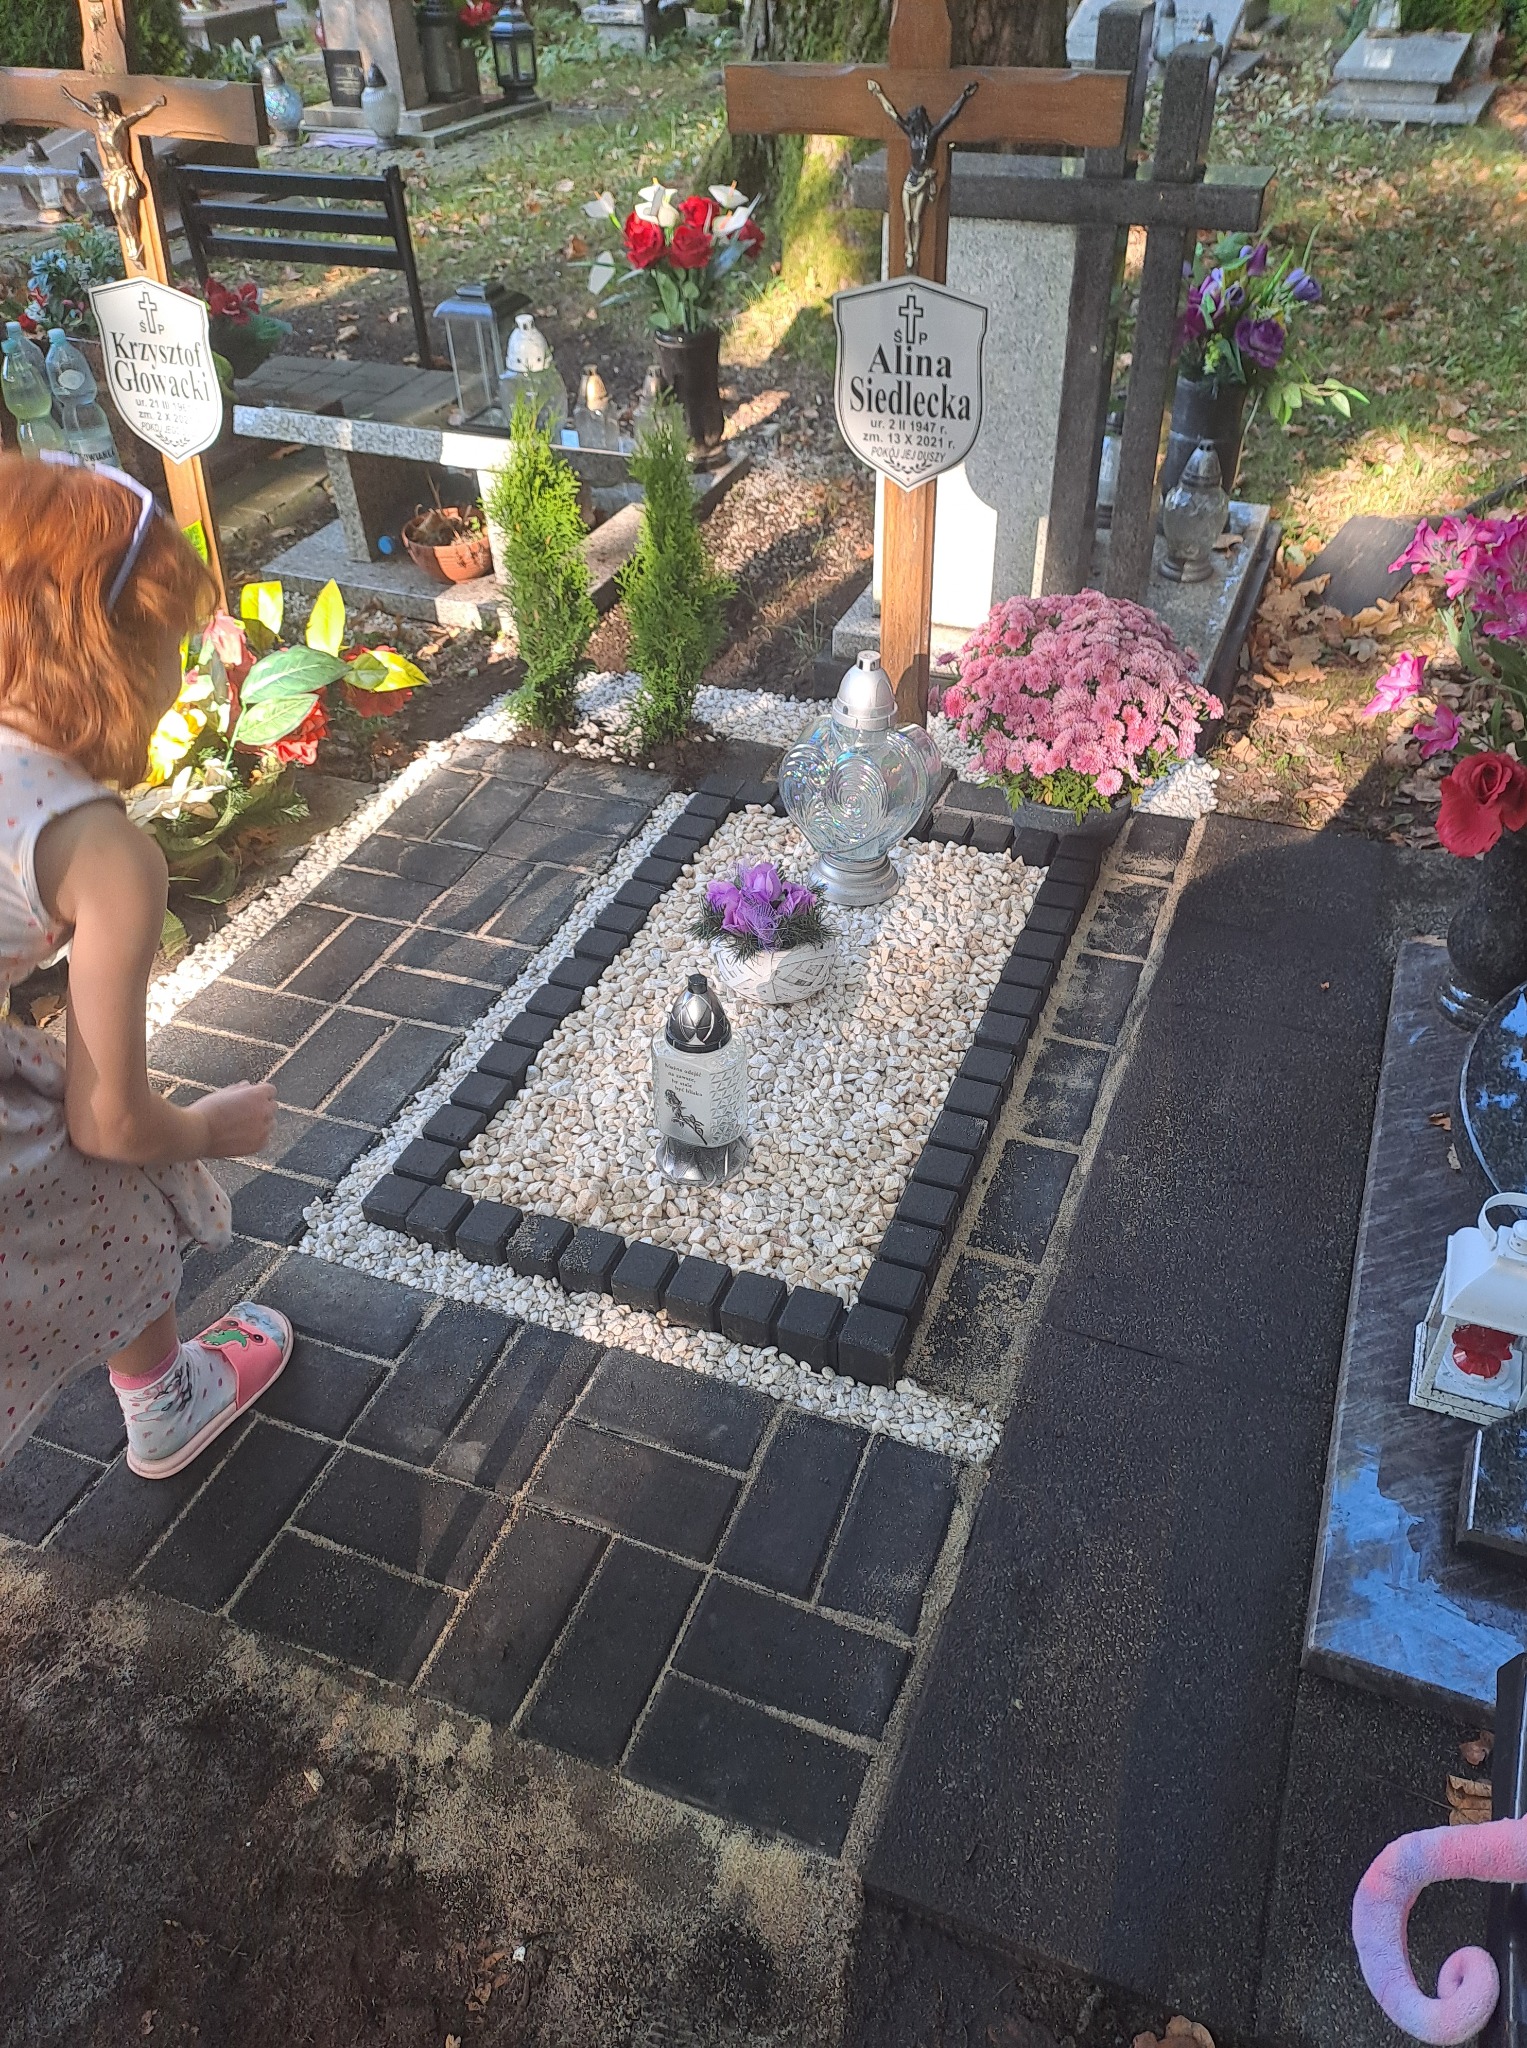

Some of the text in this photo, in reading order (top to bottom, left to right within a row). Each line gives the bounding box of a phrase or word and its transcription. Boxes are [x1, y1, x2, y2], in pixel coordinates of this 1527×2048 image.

[918, 331, 928, 345] P
[109, 331, 202, 370] Krzysztof
[868, 343, 952, 378] Alina
[114, 360, 210, 402] Głowacki
[135, 398, 148, 407] ur.
[850, 376, 971, 421] Siedlecka
[870, 419, 948, 435] ur. 2 II 1947 r.
[862, 432, 956, 450] zm. 13 X 2021 r.
[870, 444, 900, 459] POKÓJ
[917, 450, 947, 463] DUSZY
